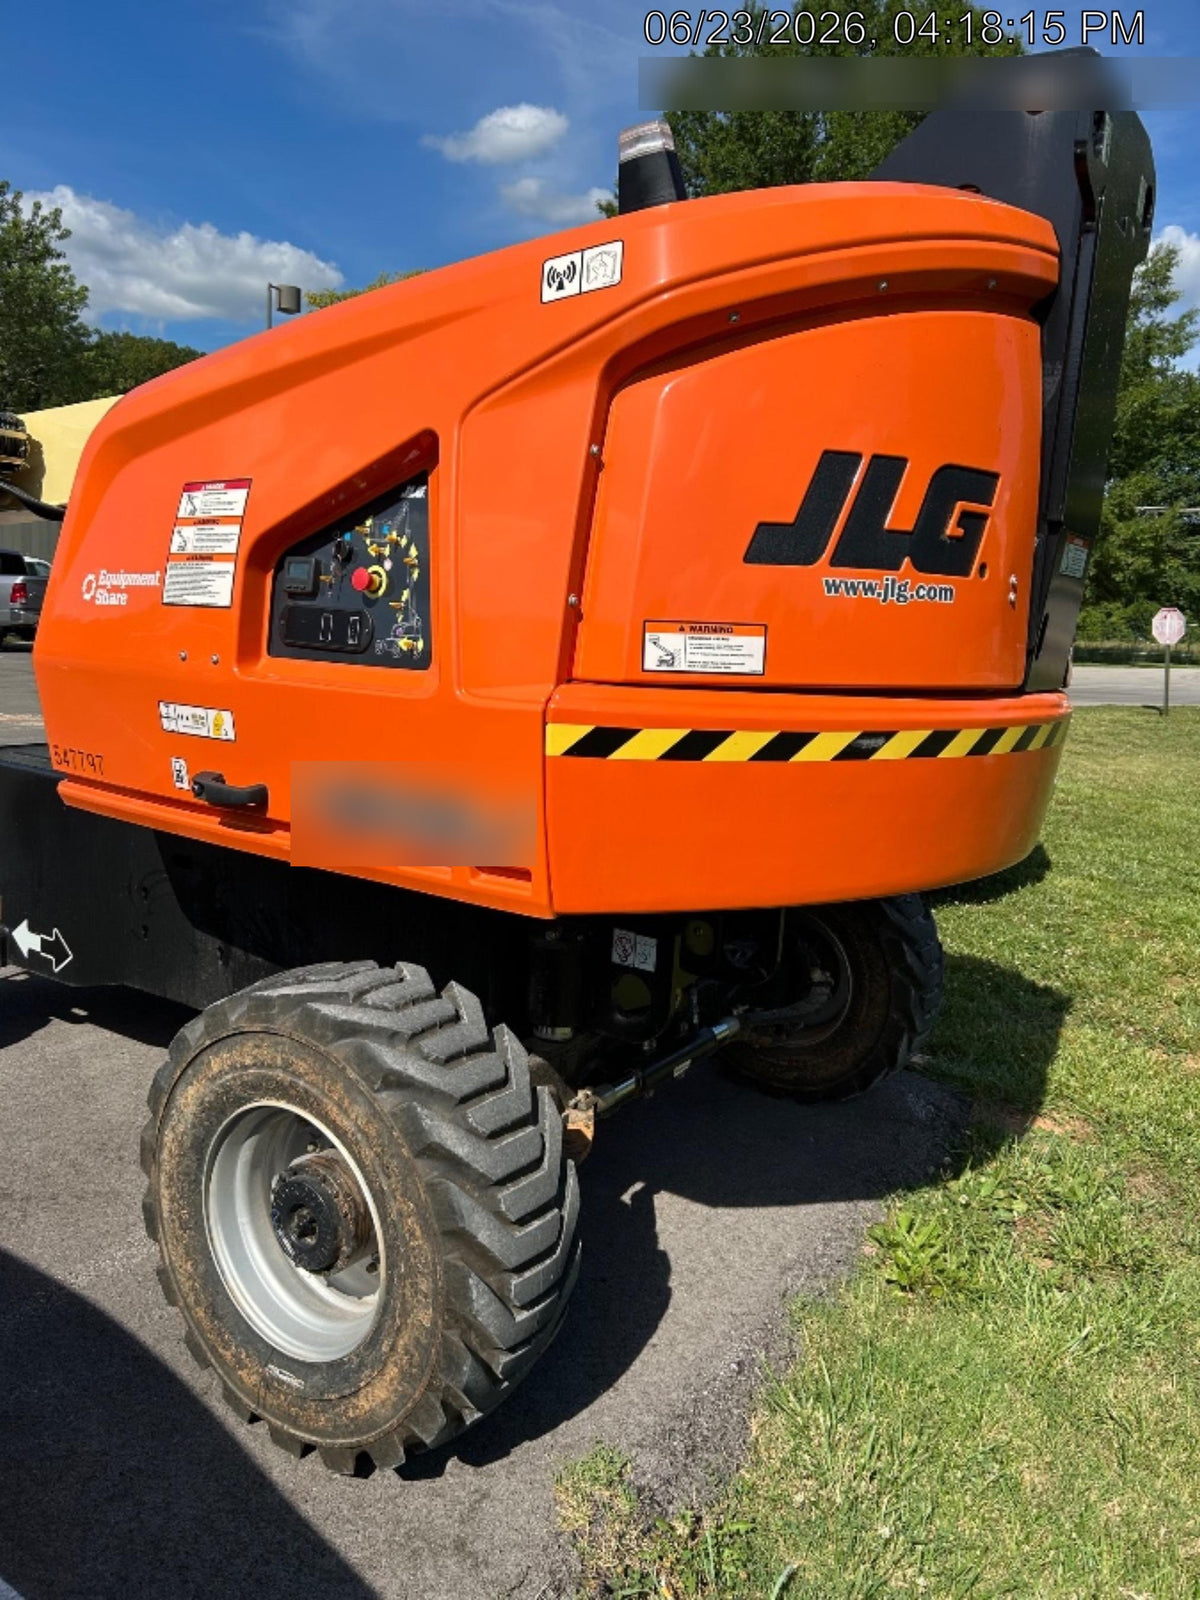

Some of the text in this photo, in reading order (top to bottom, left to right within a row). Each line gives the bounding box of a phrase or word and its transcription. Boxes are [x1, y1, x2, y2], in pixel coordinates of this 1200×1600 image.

[744, 449, 1001, 577] JLG
[97, 569, 161, 590] Equipment
[824, 576, 955, 605] www.jlg.com
[95, 589, 128, 606] Share
[52, 744, 104, 776] 547797
